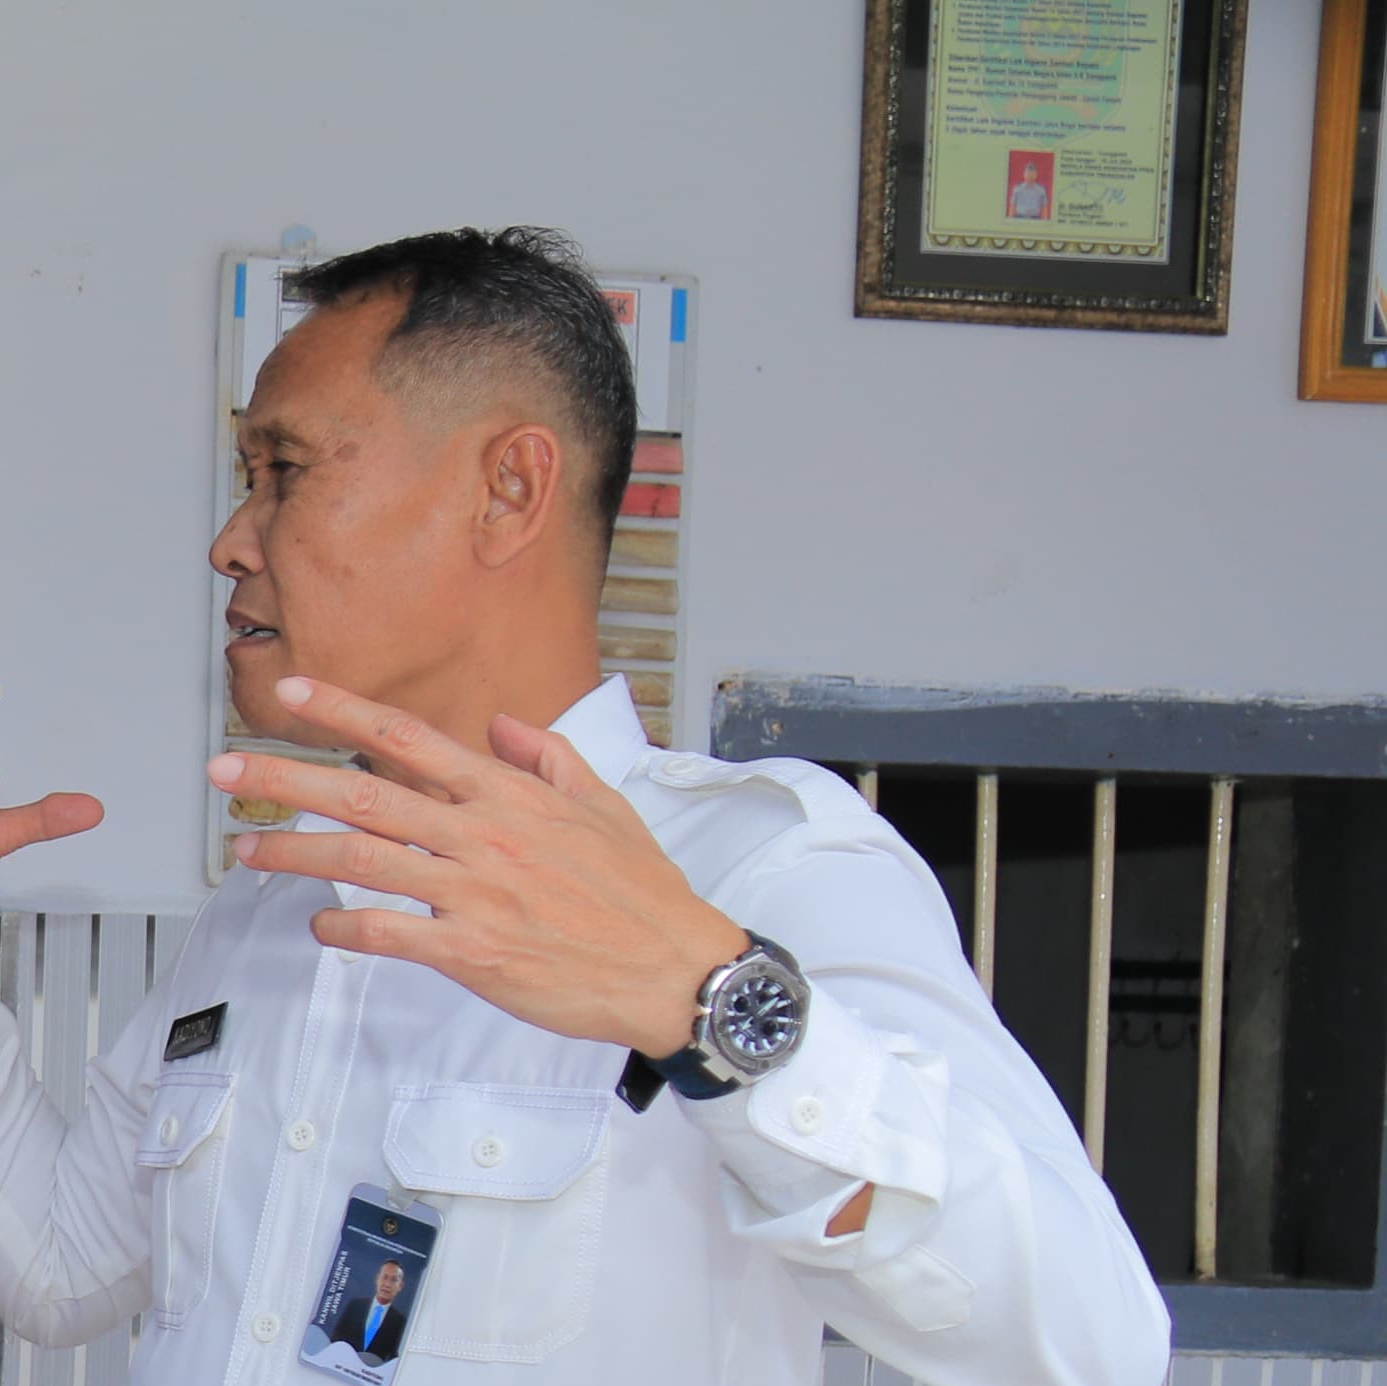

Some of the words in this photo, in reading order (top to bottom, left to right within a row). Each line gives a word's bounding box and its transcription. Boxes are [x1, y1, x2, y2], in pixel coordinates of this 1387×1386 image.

[319, 1294, 334, 1325] KANWIL
[332, 1291, 343, 1314] JAWA
[339, 1266, 352, 1290] TIMUR
